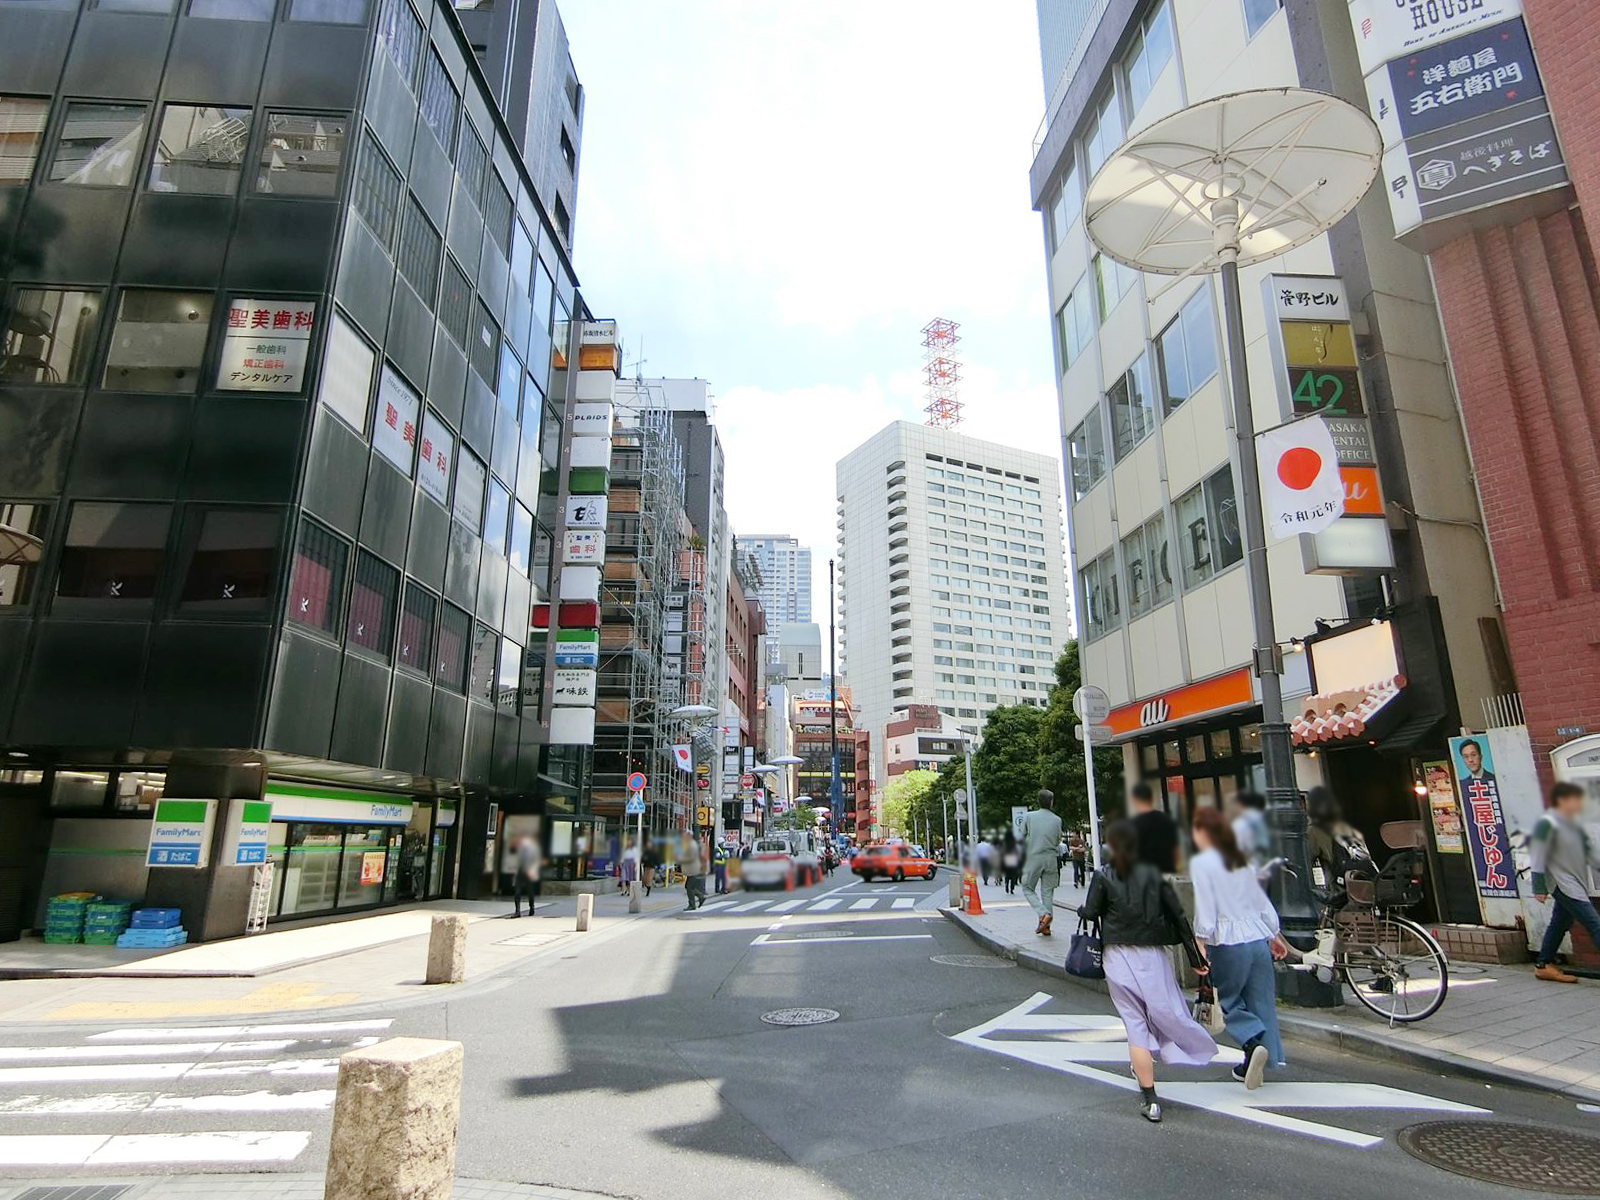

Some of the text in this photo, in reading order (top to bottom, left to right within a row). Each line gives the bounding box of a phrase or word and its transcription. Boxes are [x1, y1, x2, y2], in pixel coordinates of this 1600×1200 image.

[1410, 62, 1523, 115] 五右衛門
[1462, 140, 1552, 175] へぎそば
[228, 308, 315, 331] 聖美歯科
[230, 371, 293, 383] デンタルケア
[1292, 370, 1347, 414] 42
[1280, 500, 1337, 524] 令和元年
[1140, 698, 1169, 727] au
[369, 804, 402, 817] FamilyMart
[156, 828, 201, 837] FamilyMart
[241, 828, 267, 837] FamilyMart
[1468, 780, 1509, 889] 土屋じゅん
[170, 851, 192, 861] たばこ
